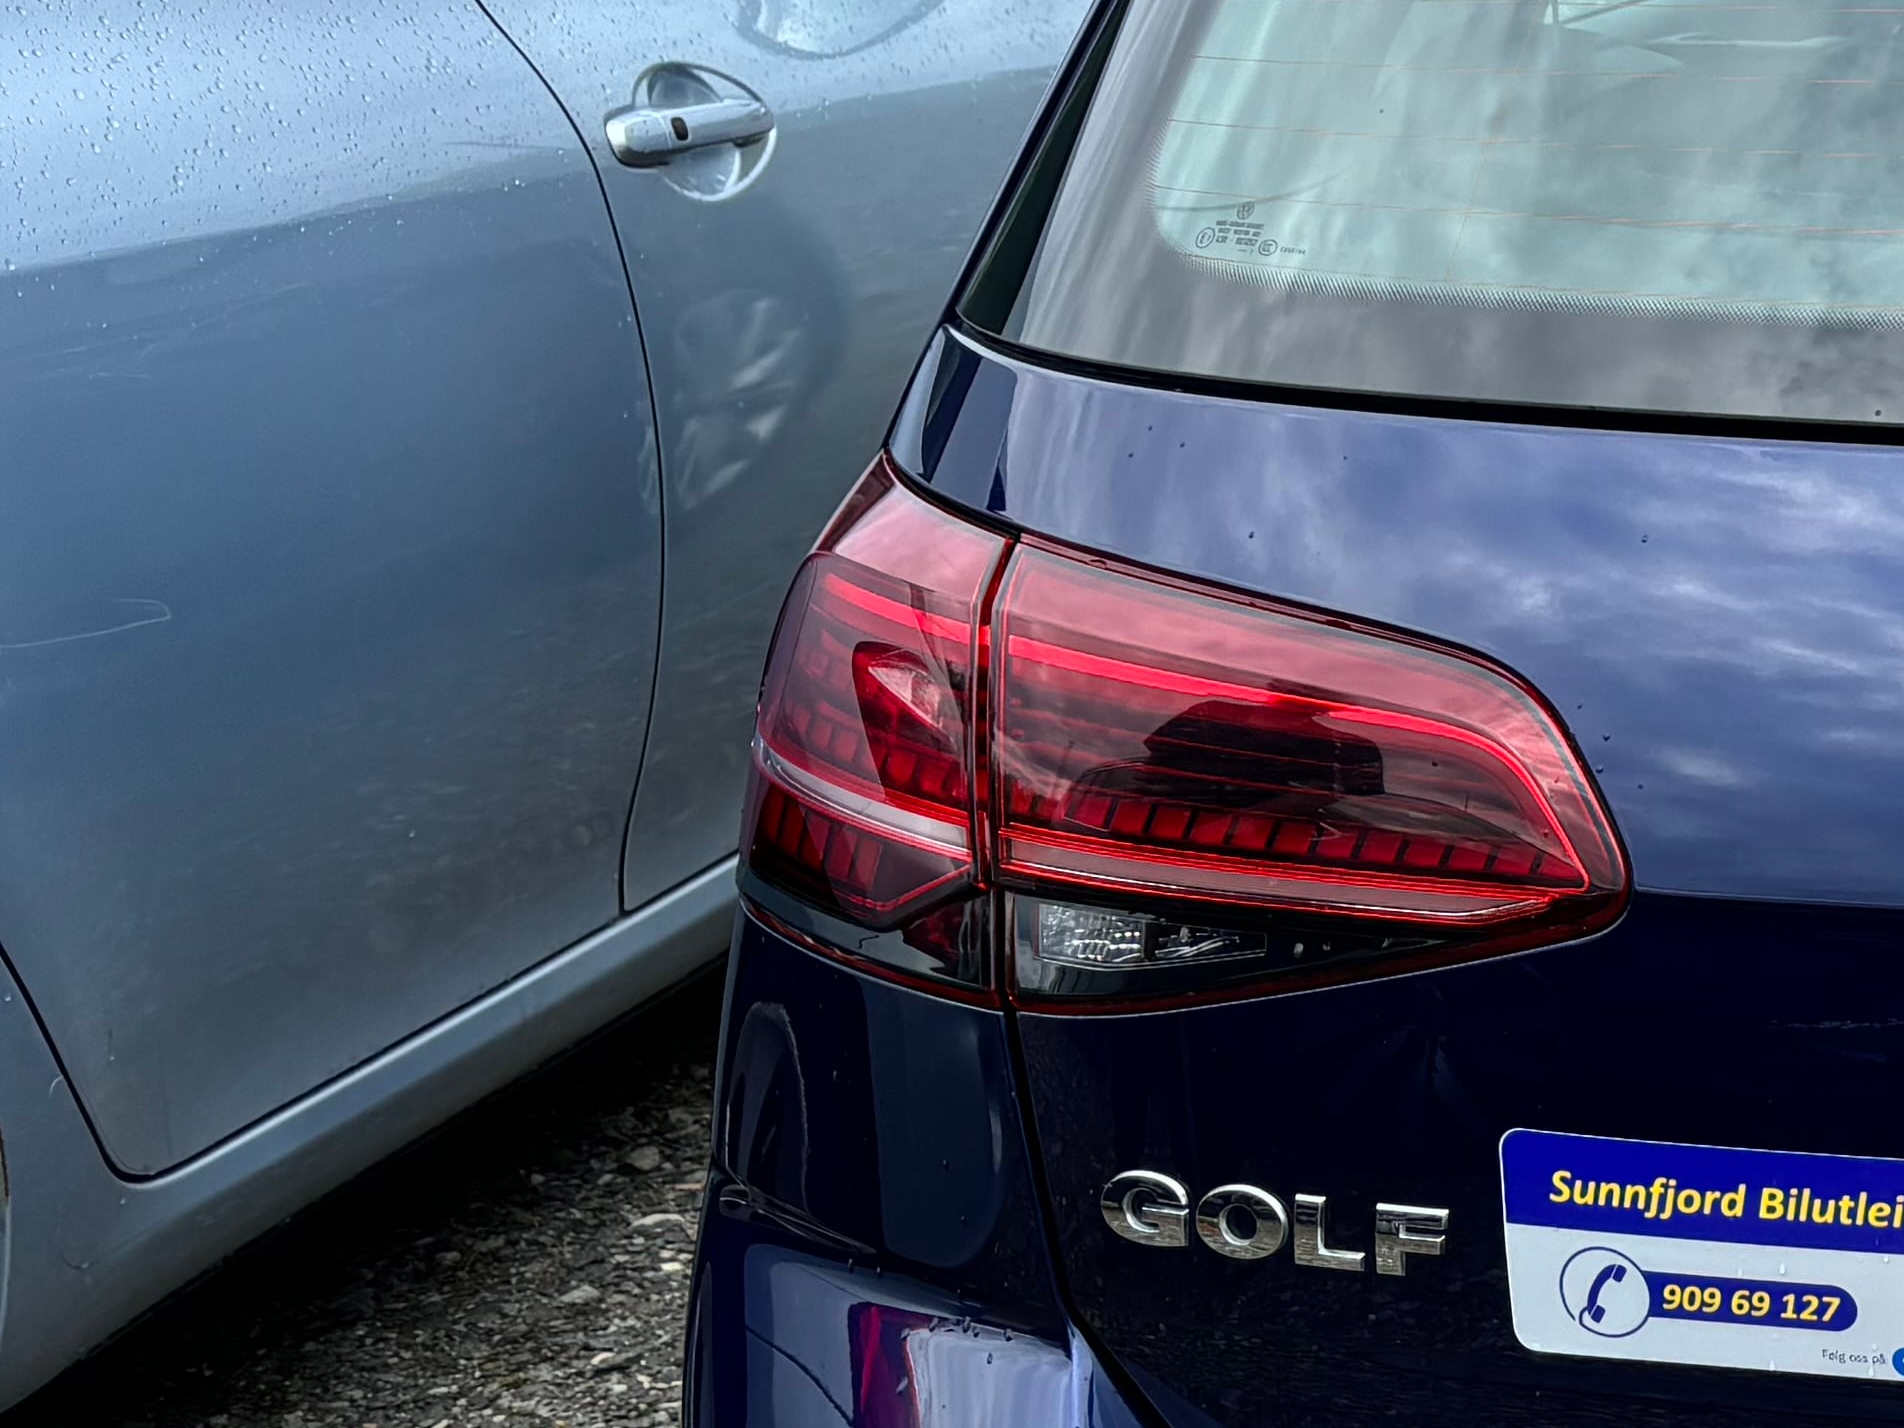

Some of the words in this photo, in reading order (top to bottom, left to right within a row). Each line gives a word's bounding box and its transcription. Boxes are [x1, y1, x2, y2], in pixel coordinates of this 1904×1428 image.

[1549, 1170, 1746, 1220] Sunnfjord
[1100, 1169, 1450, 1277] GOLF
[1662, 1283, 1722, 1313] 909
[1731, 1290, 1771, 1317] 69
[1781, 1294, 1841, 1322] 127
